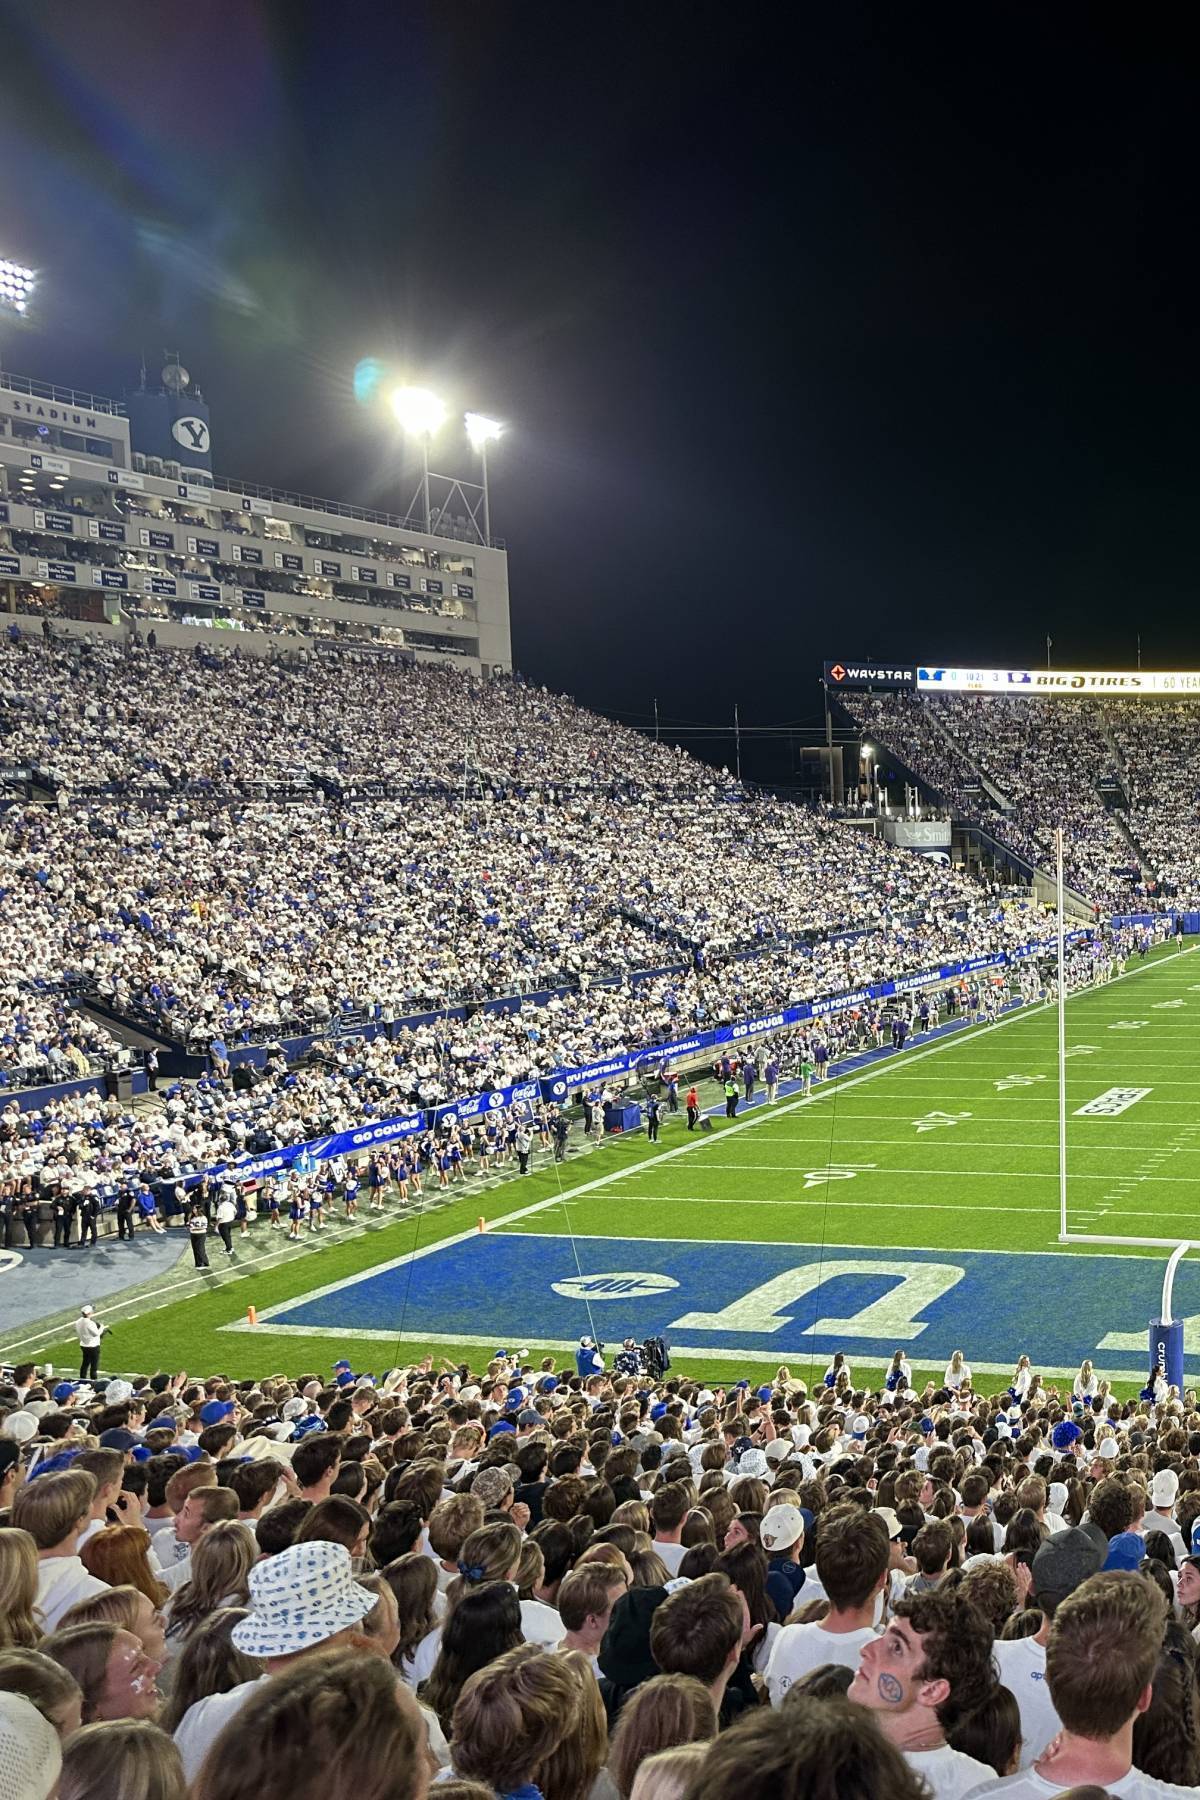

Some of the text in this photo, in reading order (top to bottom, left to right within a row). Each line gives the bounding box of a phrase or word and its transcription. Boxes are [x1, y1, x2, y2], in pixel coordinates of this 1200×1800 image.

[14, 400, 96, 428] STADIUM
[847, 668, 912, 681] WAYSTAR
[1037, 676, 1068, 686] BIG
[1088, 676, 1142, 686] TIRES
[1164, 676, 1175, 689] 60
[924, 827, 948, 842] Smit
[811, 990, 871, 1015] BYU FOOTBALL
[732, 1015, 784, 1038] GO COUGS
[663, 1039, 700, 1056] FOOTBALL
[581, 1061, 624, 1080] FOOTBALL
[911, 1111, 973, 1127] 20
[352, 1119, 419, 1144] GO COUGS
[803, 1163, 878, 1180] 10
